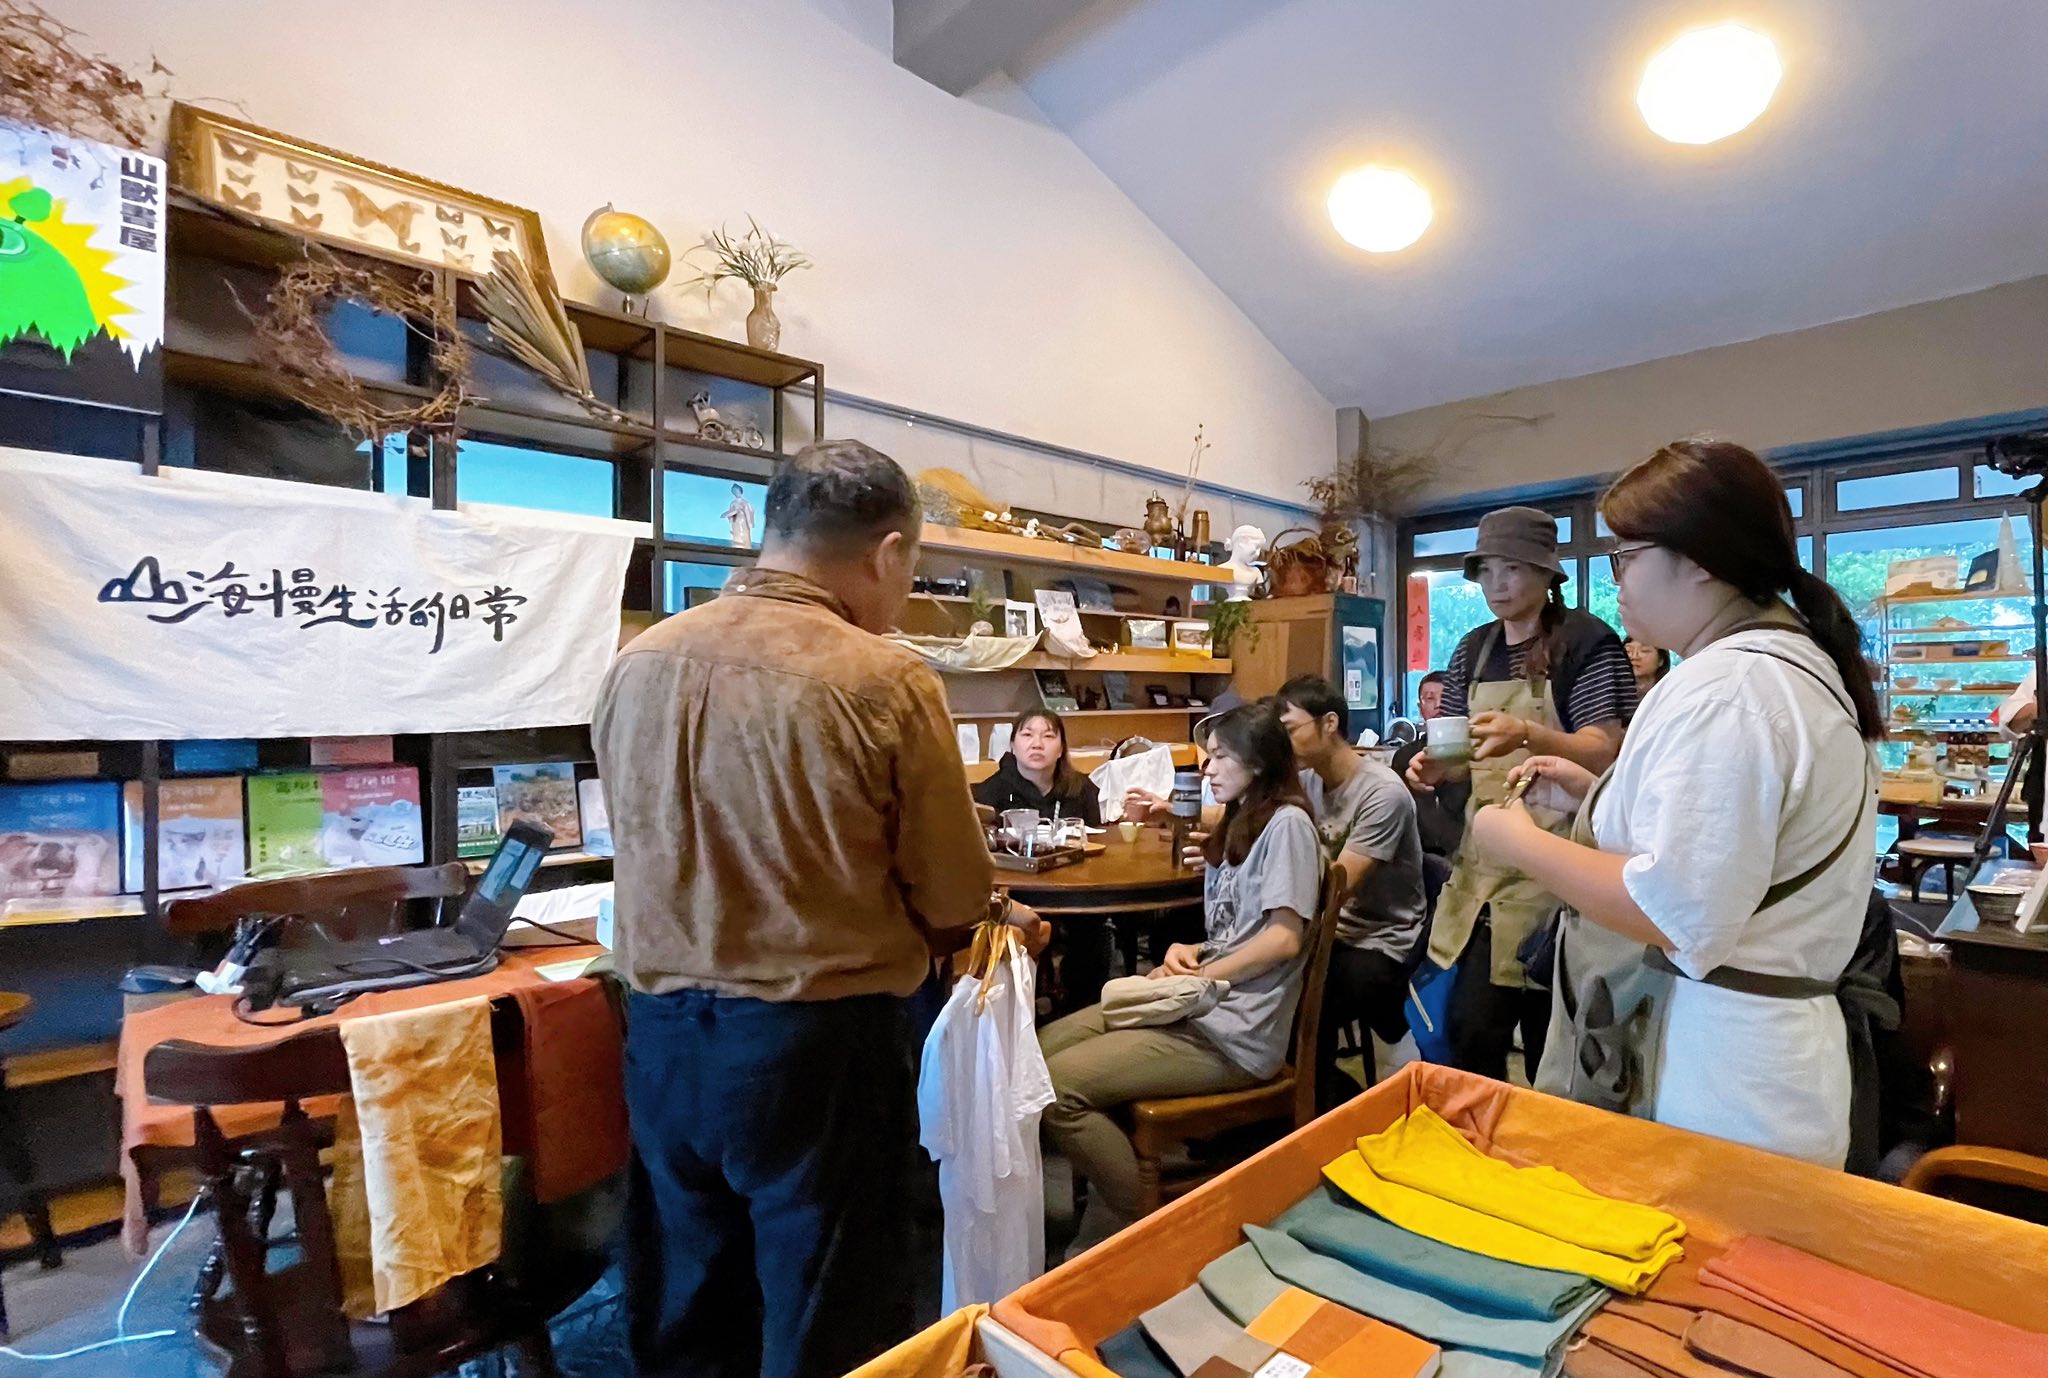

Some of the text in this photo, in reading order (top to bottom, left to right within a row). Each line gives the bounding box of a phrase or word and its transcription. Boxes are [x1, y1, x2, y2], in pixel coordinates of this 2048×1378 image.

[98, 556, 527, 654] 山海慢生活的日常
